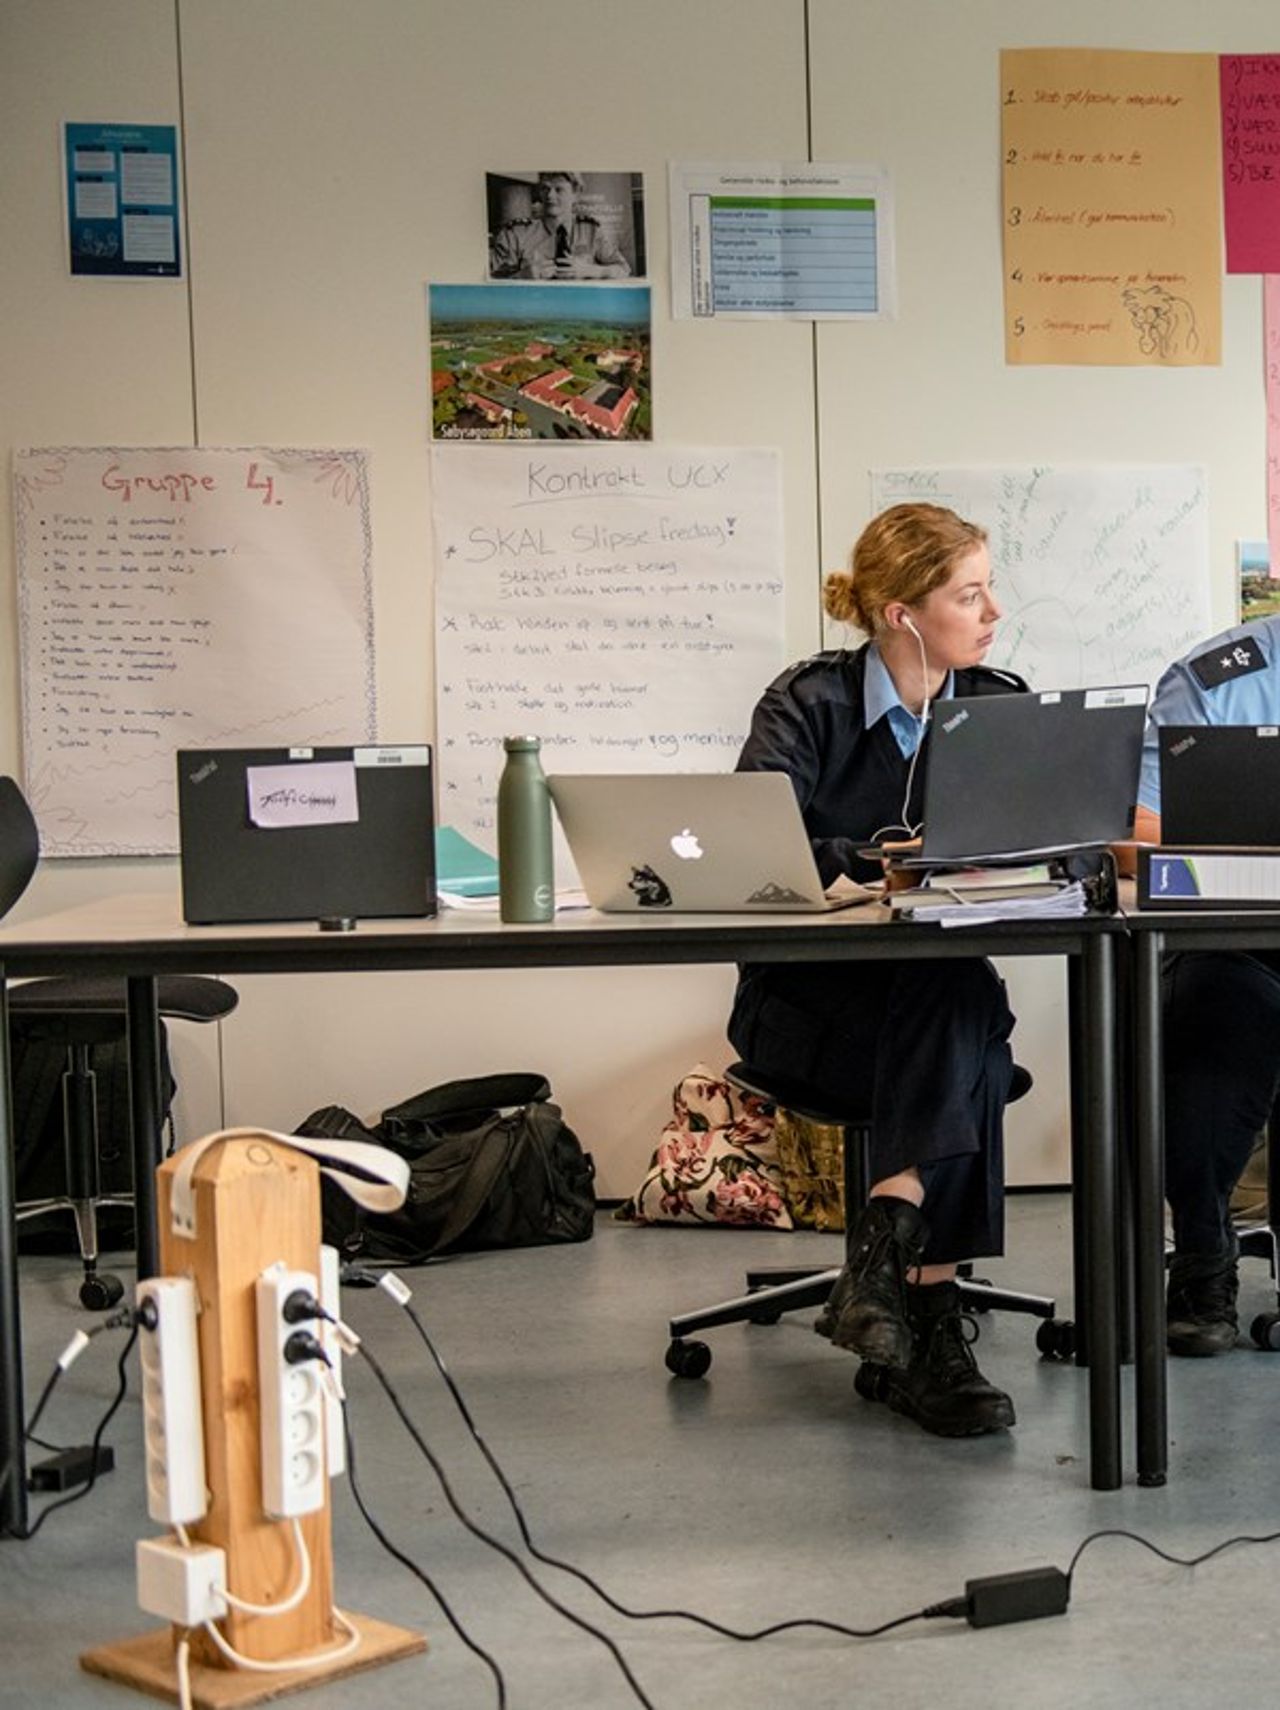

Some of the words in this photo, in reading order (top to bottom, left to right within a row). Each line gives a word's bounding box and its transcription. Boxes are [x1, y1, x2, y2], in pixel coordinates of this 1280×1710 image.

[101, 463, 219, 503] Gruppe
[528, 462, 647, 498] Kontrakt
[667, 462, 731, 491] UCX
[464, 526, 558, 564] SKAL
[571, 527, 648, 555] Slipse
